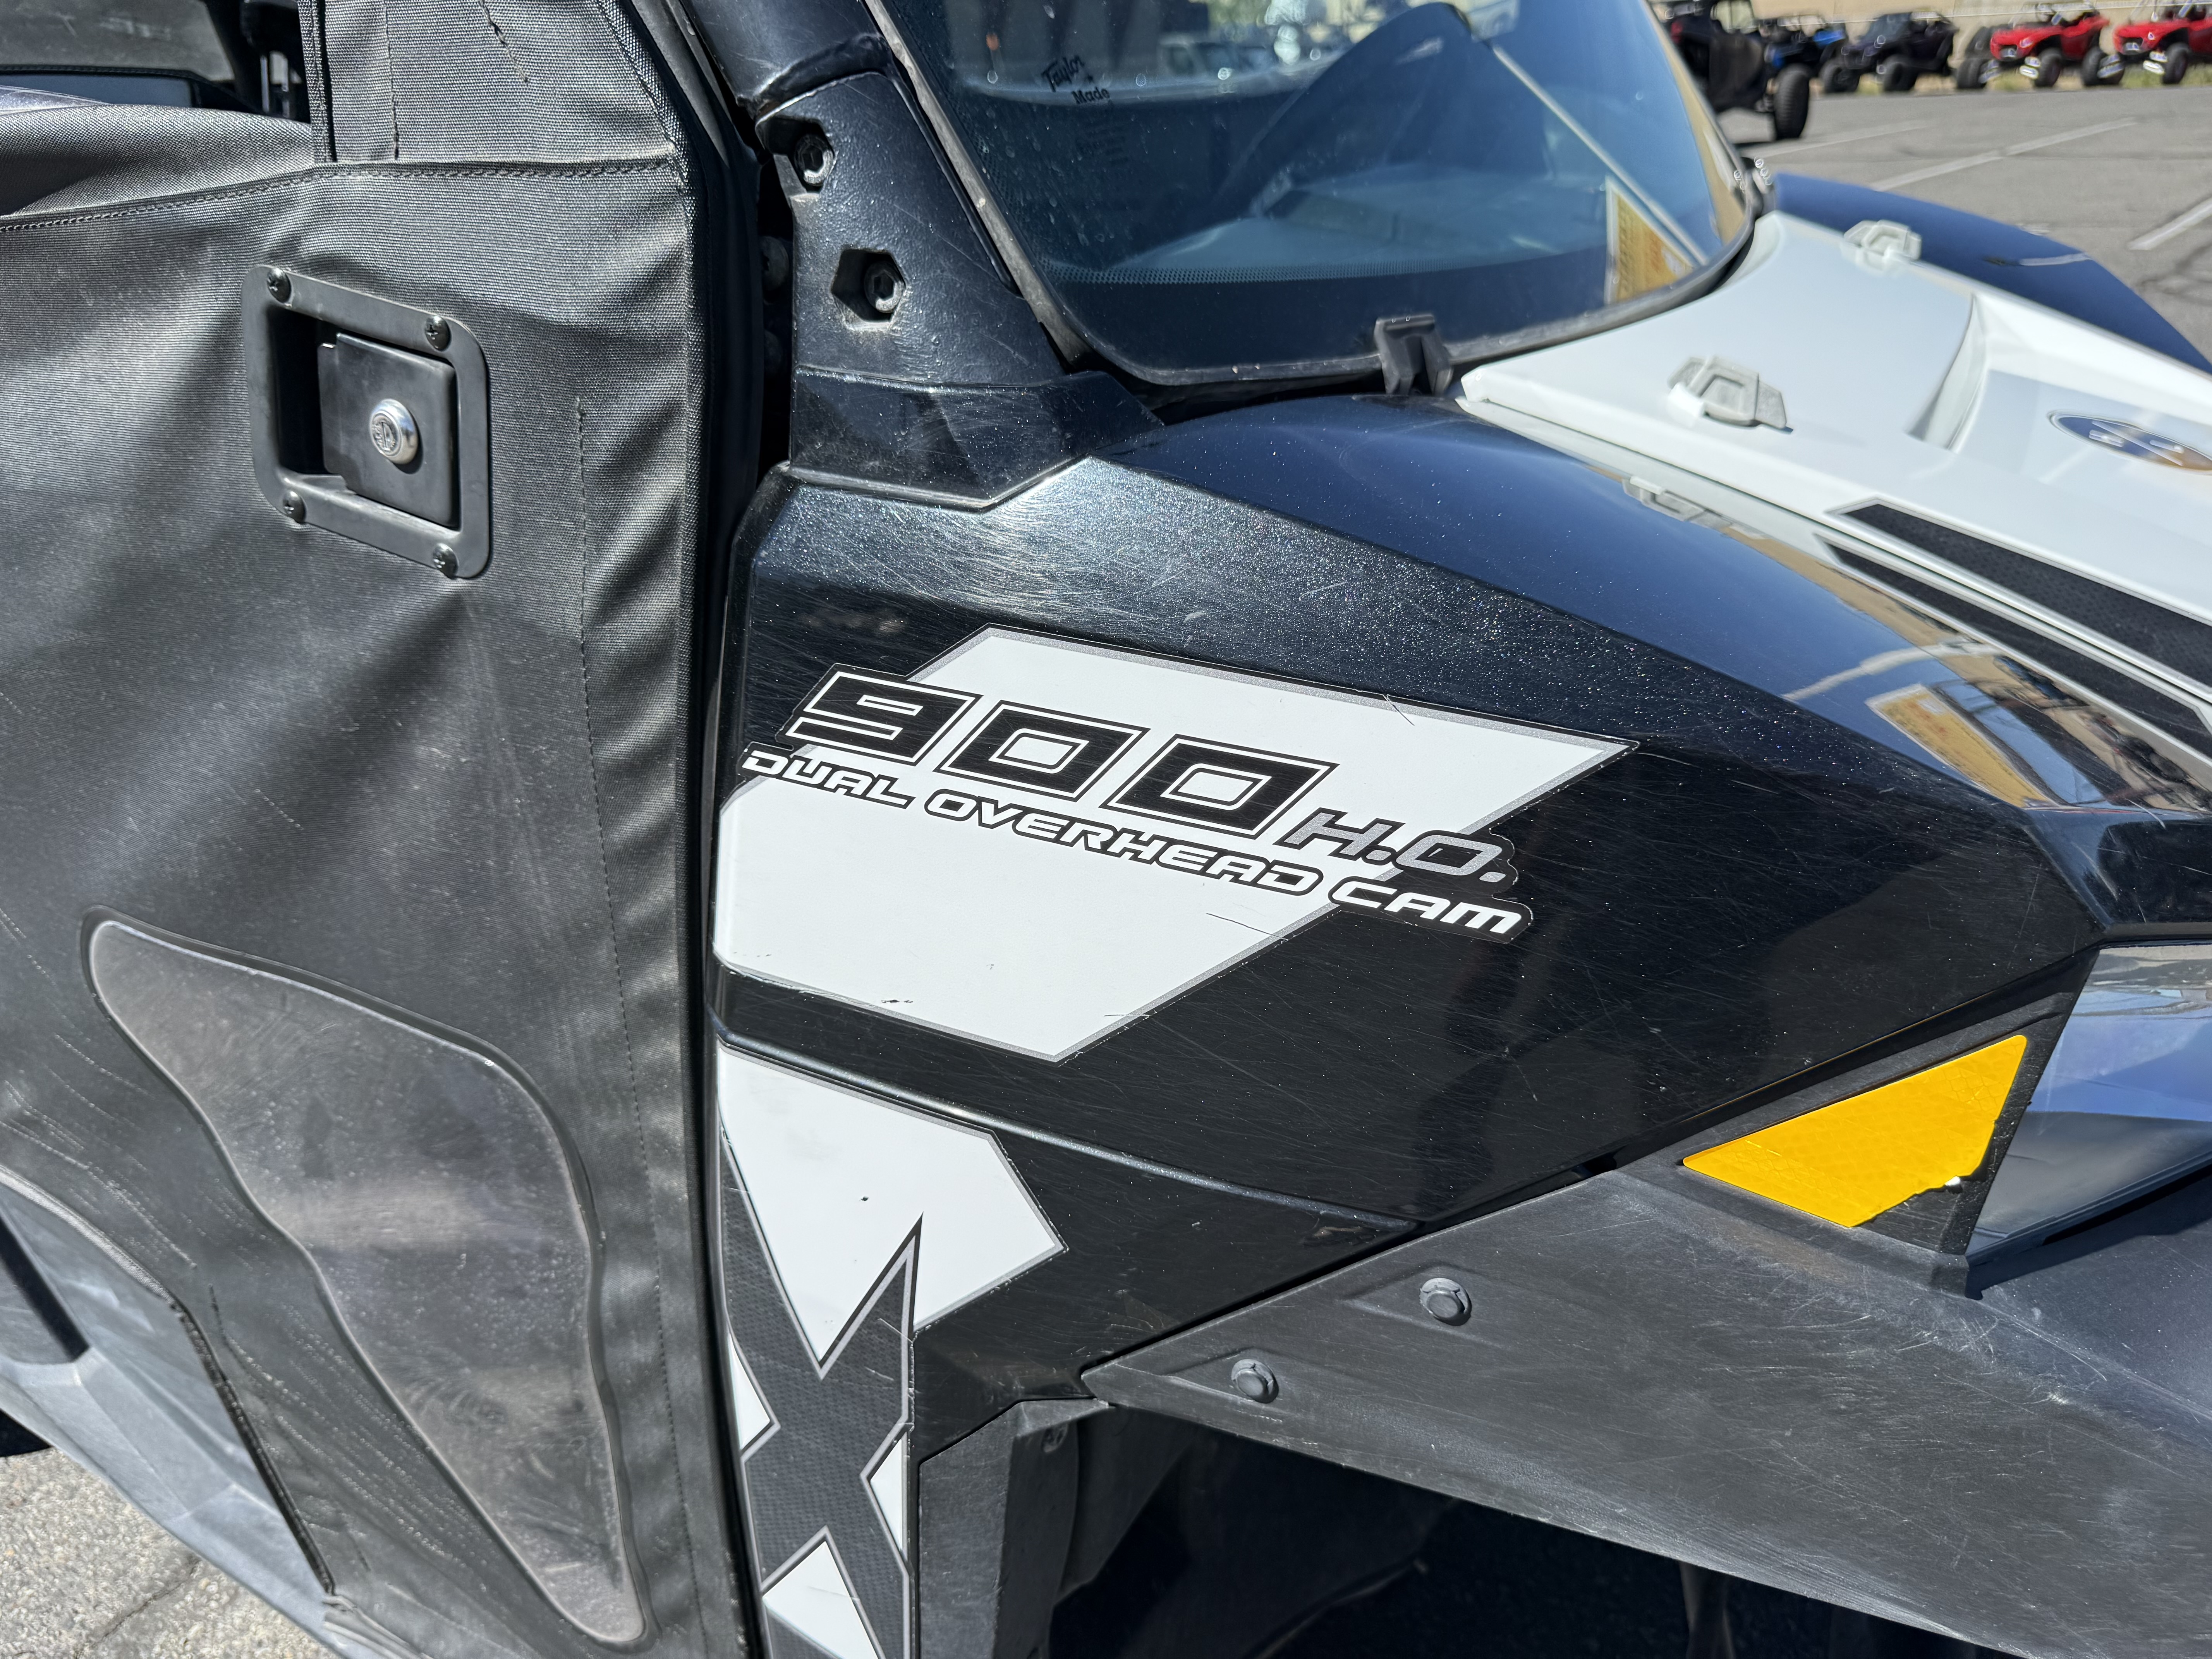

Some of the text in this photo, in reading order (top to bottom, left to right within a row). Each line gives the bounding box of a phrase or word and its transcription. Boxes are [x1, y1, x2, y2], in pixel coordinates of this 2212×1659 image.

[1041, 55, 1085, 93] Taylor
[1071, 87, 1111, 105] Made
[782, 669, 1508, 883] 900 H.O.
[741, 749, 1523, 935] DUAL OVERHEAD CAM
